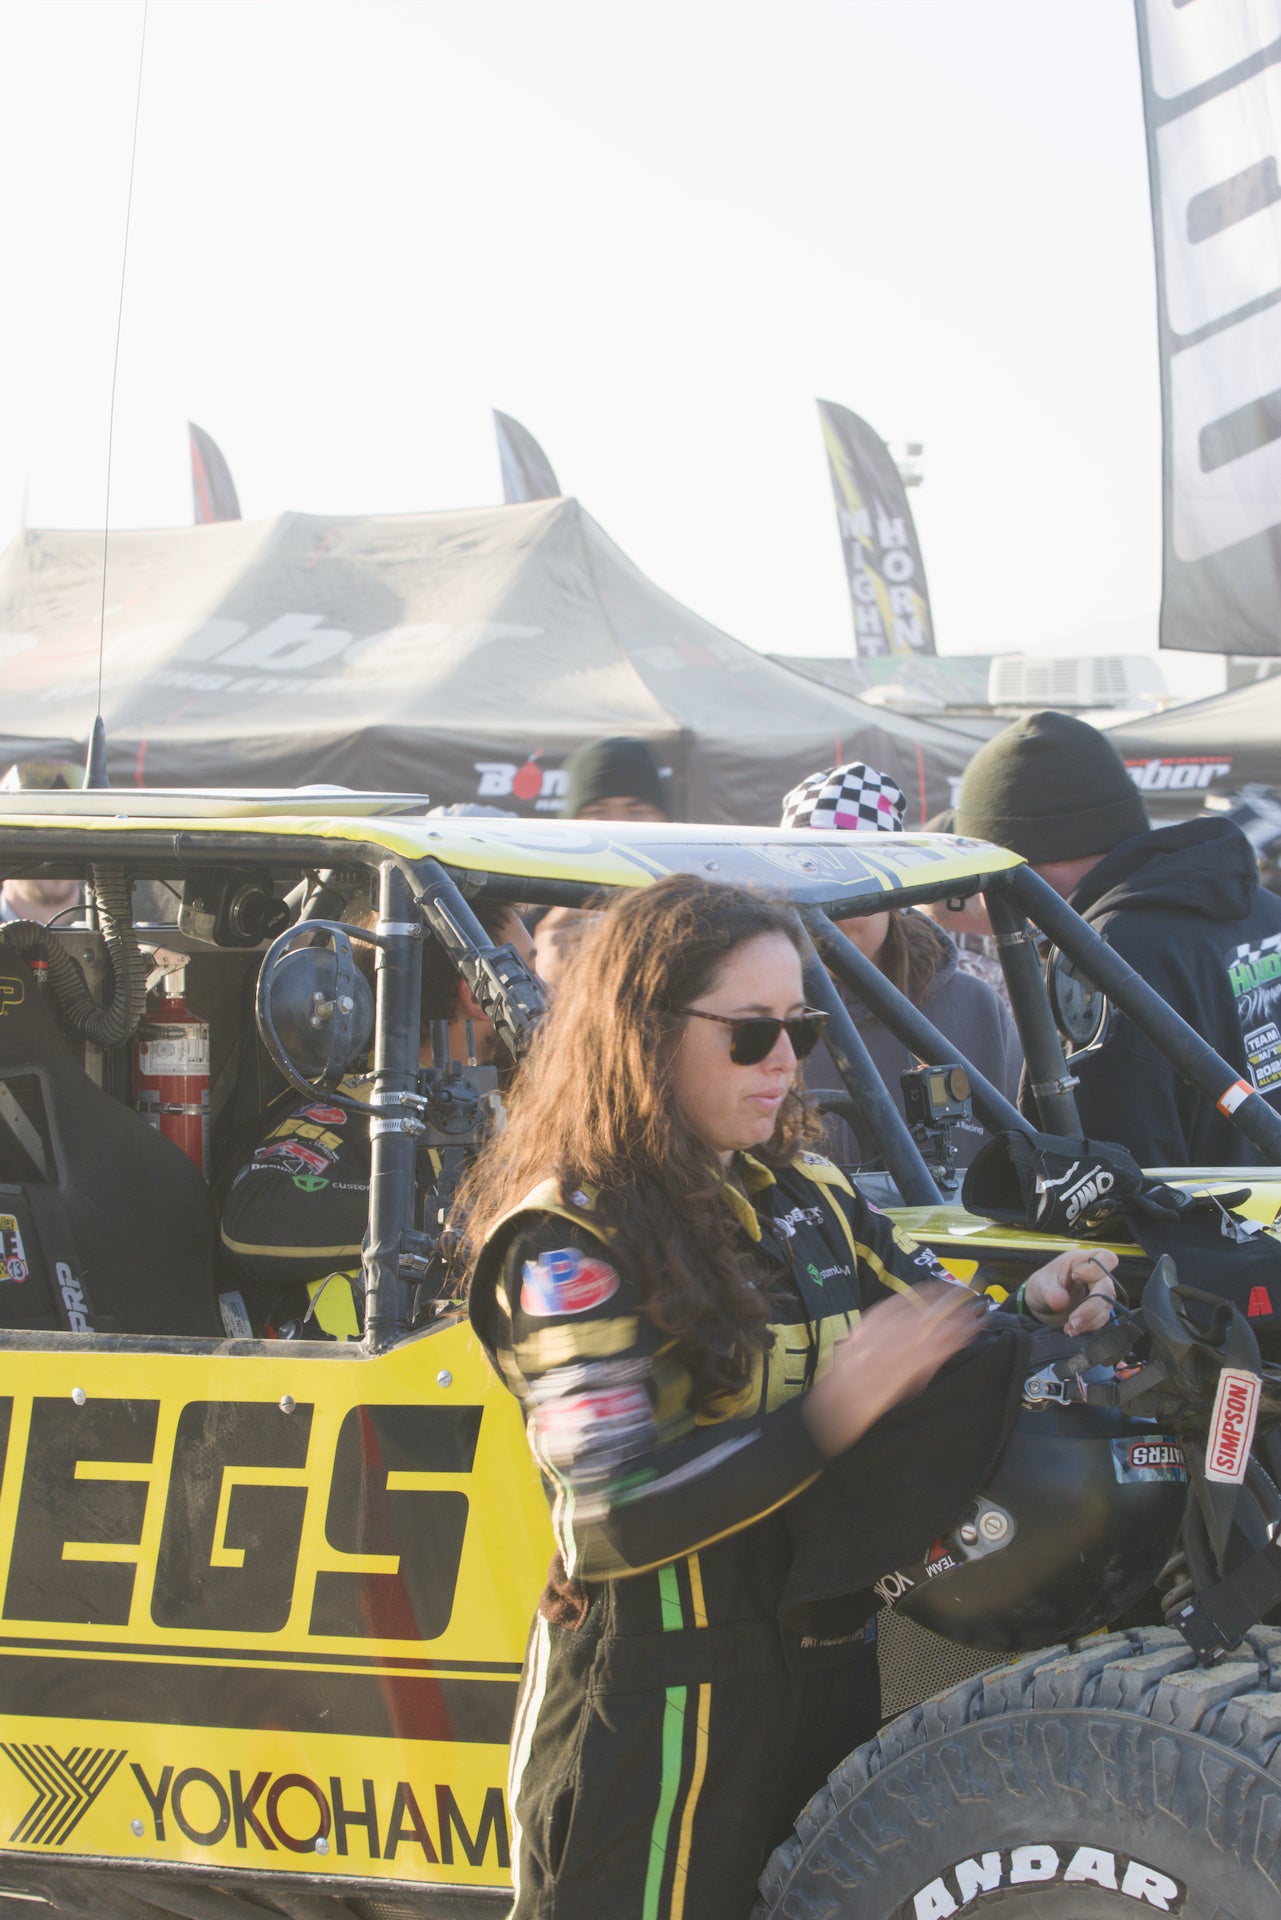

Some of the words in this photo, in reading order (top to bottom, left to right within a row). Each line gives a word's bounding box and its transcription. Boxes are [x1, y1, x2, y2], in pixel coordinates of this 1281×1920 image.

[1248, 1029, 1278, 1050] TEAM
[1256, 1060, 1281, 1080] 202
[1066, 1172, 1114, 1220] OMP
[55, 1262, 95, 1333] PRP
[1217, 1383, 1248, 1470] SIMPSON
[0, 1396, 485, 1642] EGS
[924, 1555, 956, 1578] TEAM
